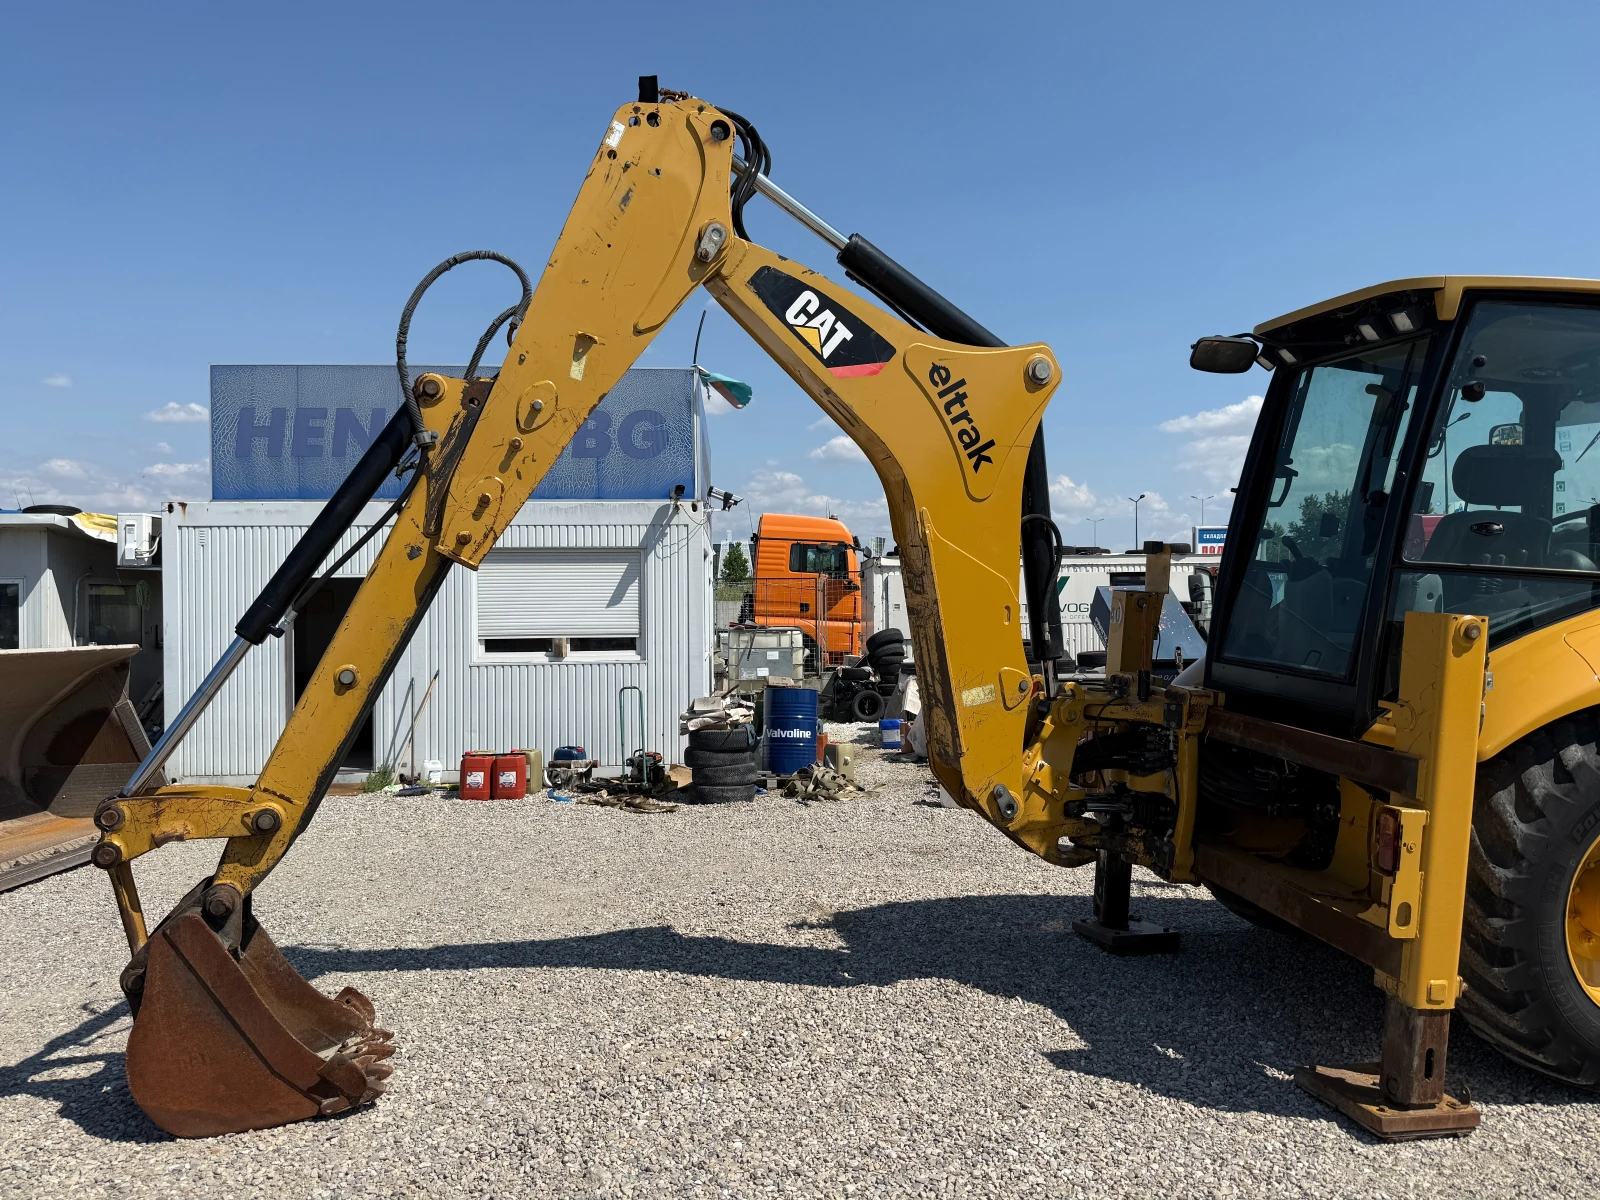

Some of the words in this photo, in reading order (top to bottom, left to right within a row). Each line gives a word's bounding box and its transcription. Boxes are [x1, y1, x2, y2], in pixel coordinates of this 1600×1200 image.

[785, 290, 853, 360] CAT
[570, 409, 669, 460] BG
[928, 361, 996, 474] eltrak
[1060, 603, 1091, 612] VOG
[766, 728, 812, 739] Valvoline
